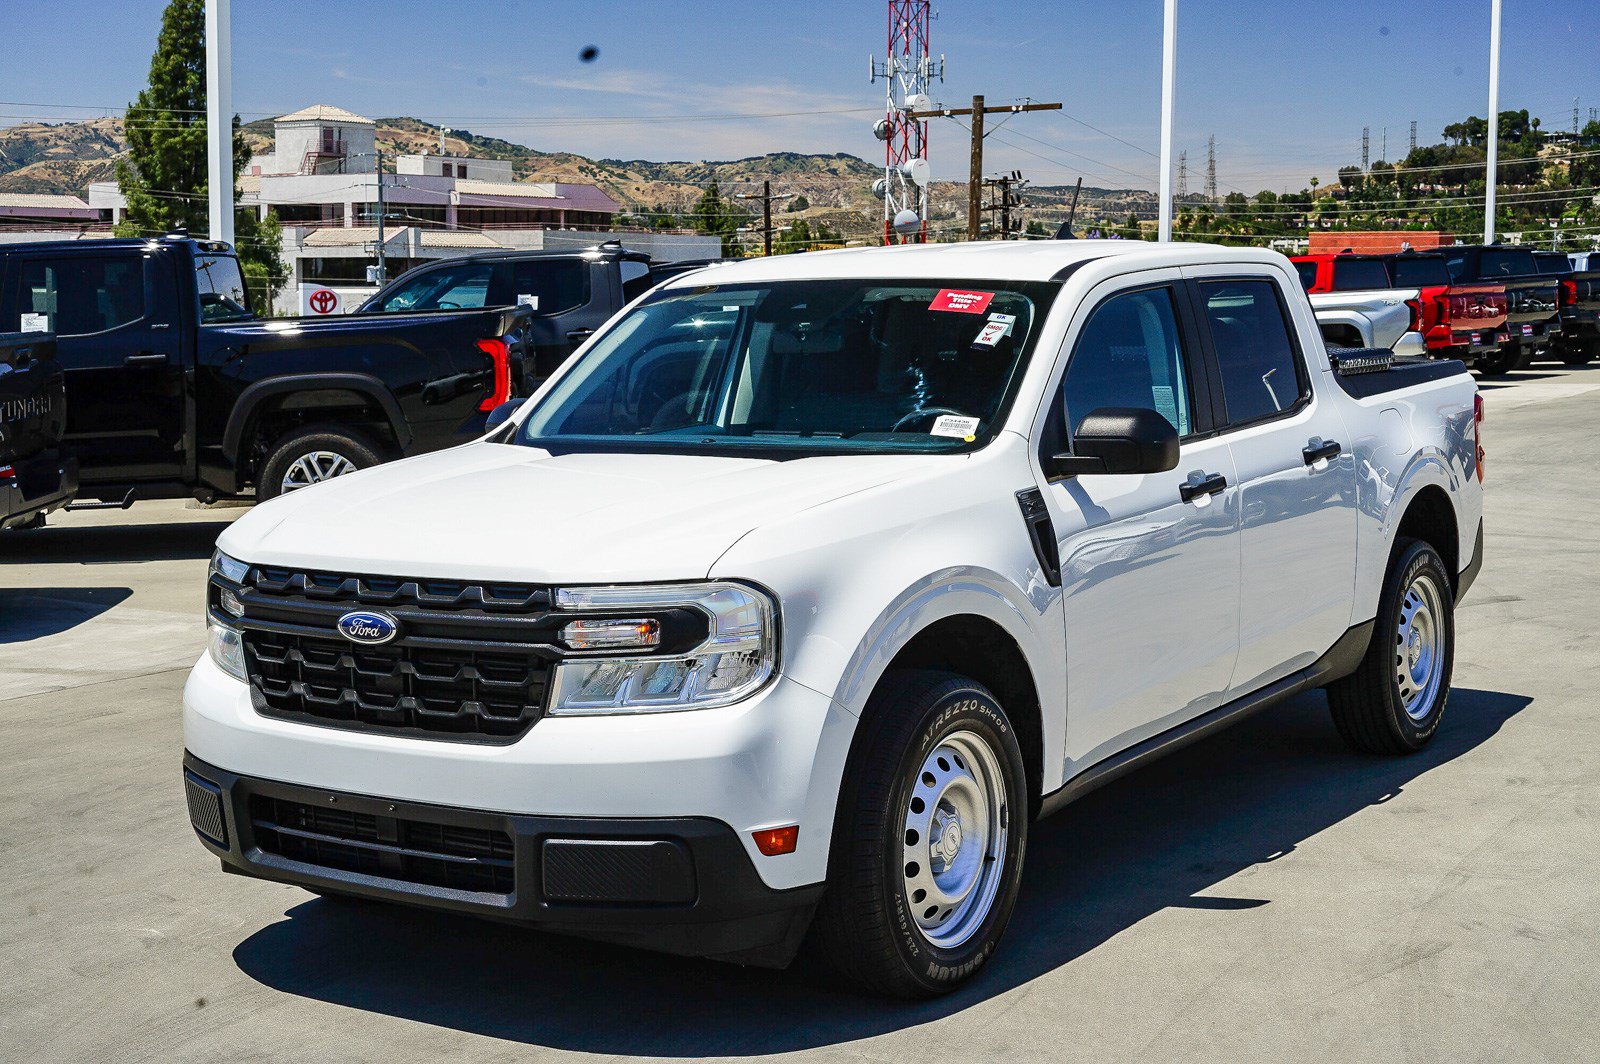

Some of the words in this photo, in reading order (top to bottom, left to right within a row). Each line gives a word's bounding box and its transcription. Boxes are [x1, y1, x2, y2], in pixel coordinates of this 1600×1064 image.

[946, 292, 983, 301] Pending
[349, 618, 381, 637] Ford
[921, 699, 979, 751] ATREZZO
[979, 705, 1007, 733] SH408
[926, 952, 984, 980] SAILUN
